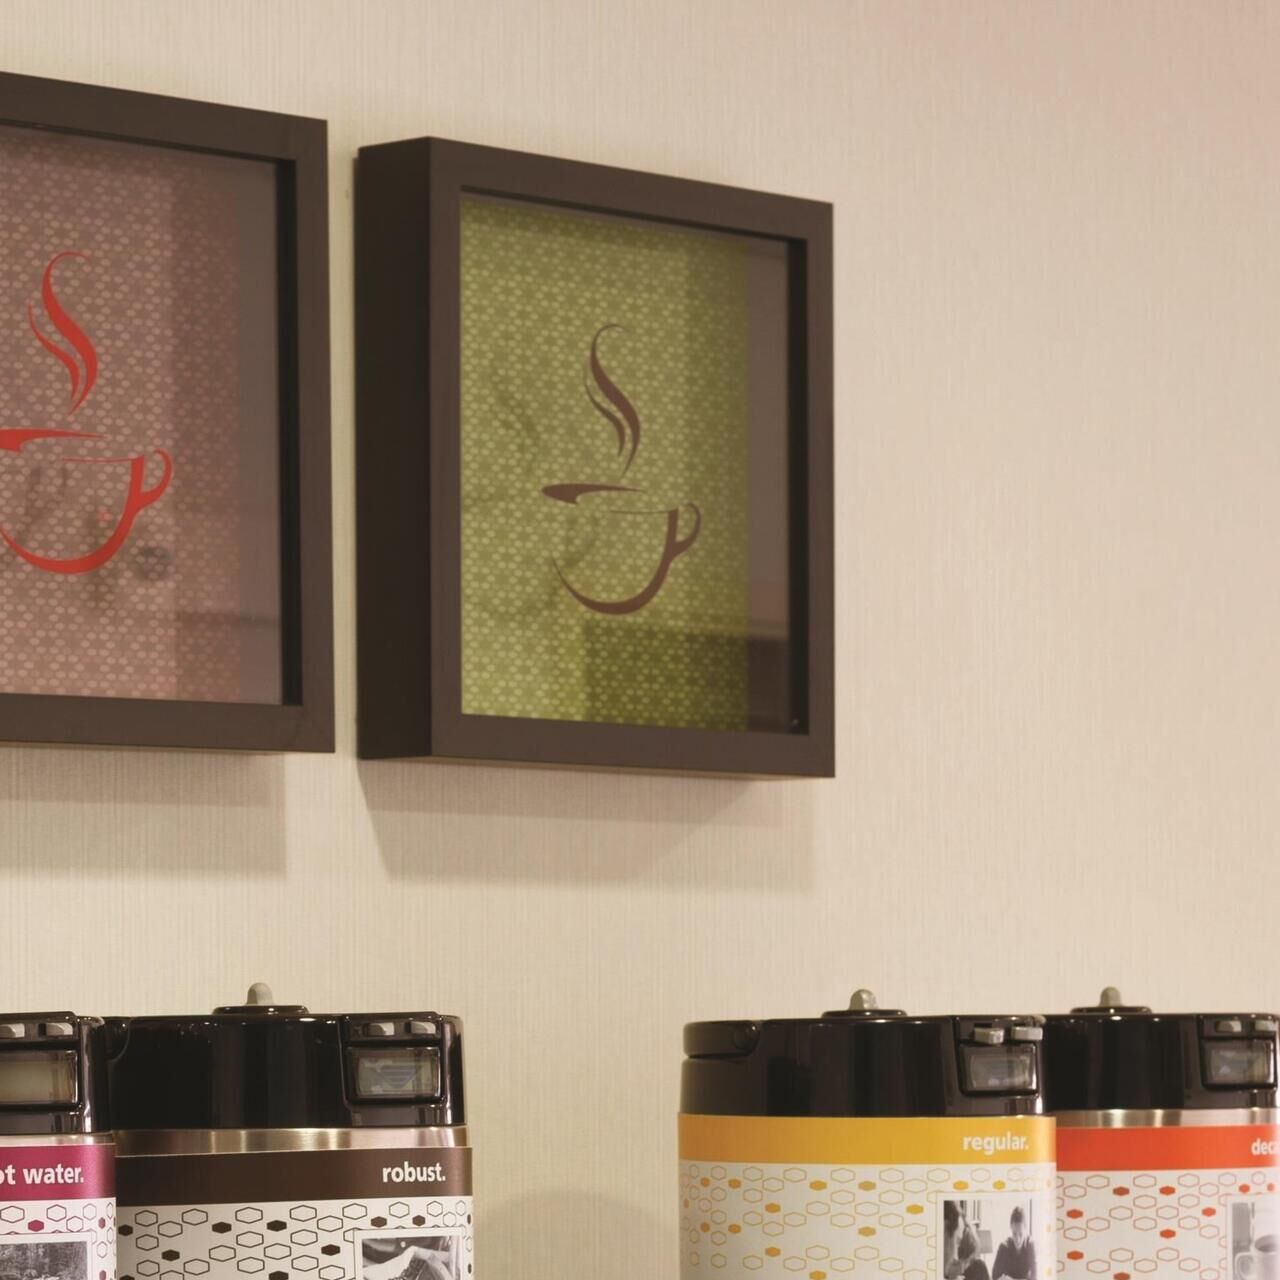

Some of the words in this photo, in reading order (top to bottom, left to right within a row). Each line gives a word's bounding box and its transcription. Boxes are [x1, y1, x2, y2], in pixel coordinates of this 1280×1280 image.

[962, 1131, 1030, 1156] regular.
[22, 1163, 84, 1185] water.
[382, 1161, 446, 1182] robust.
